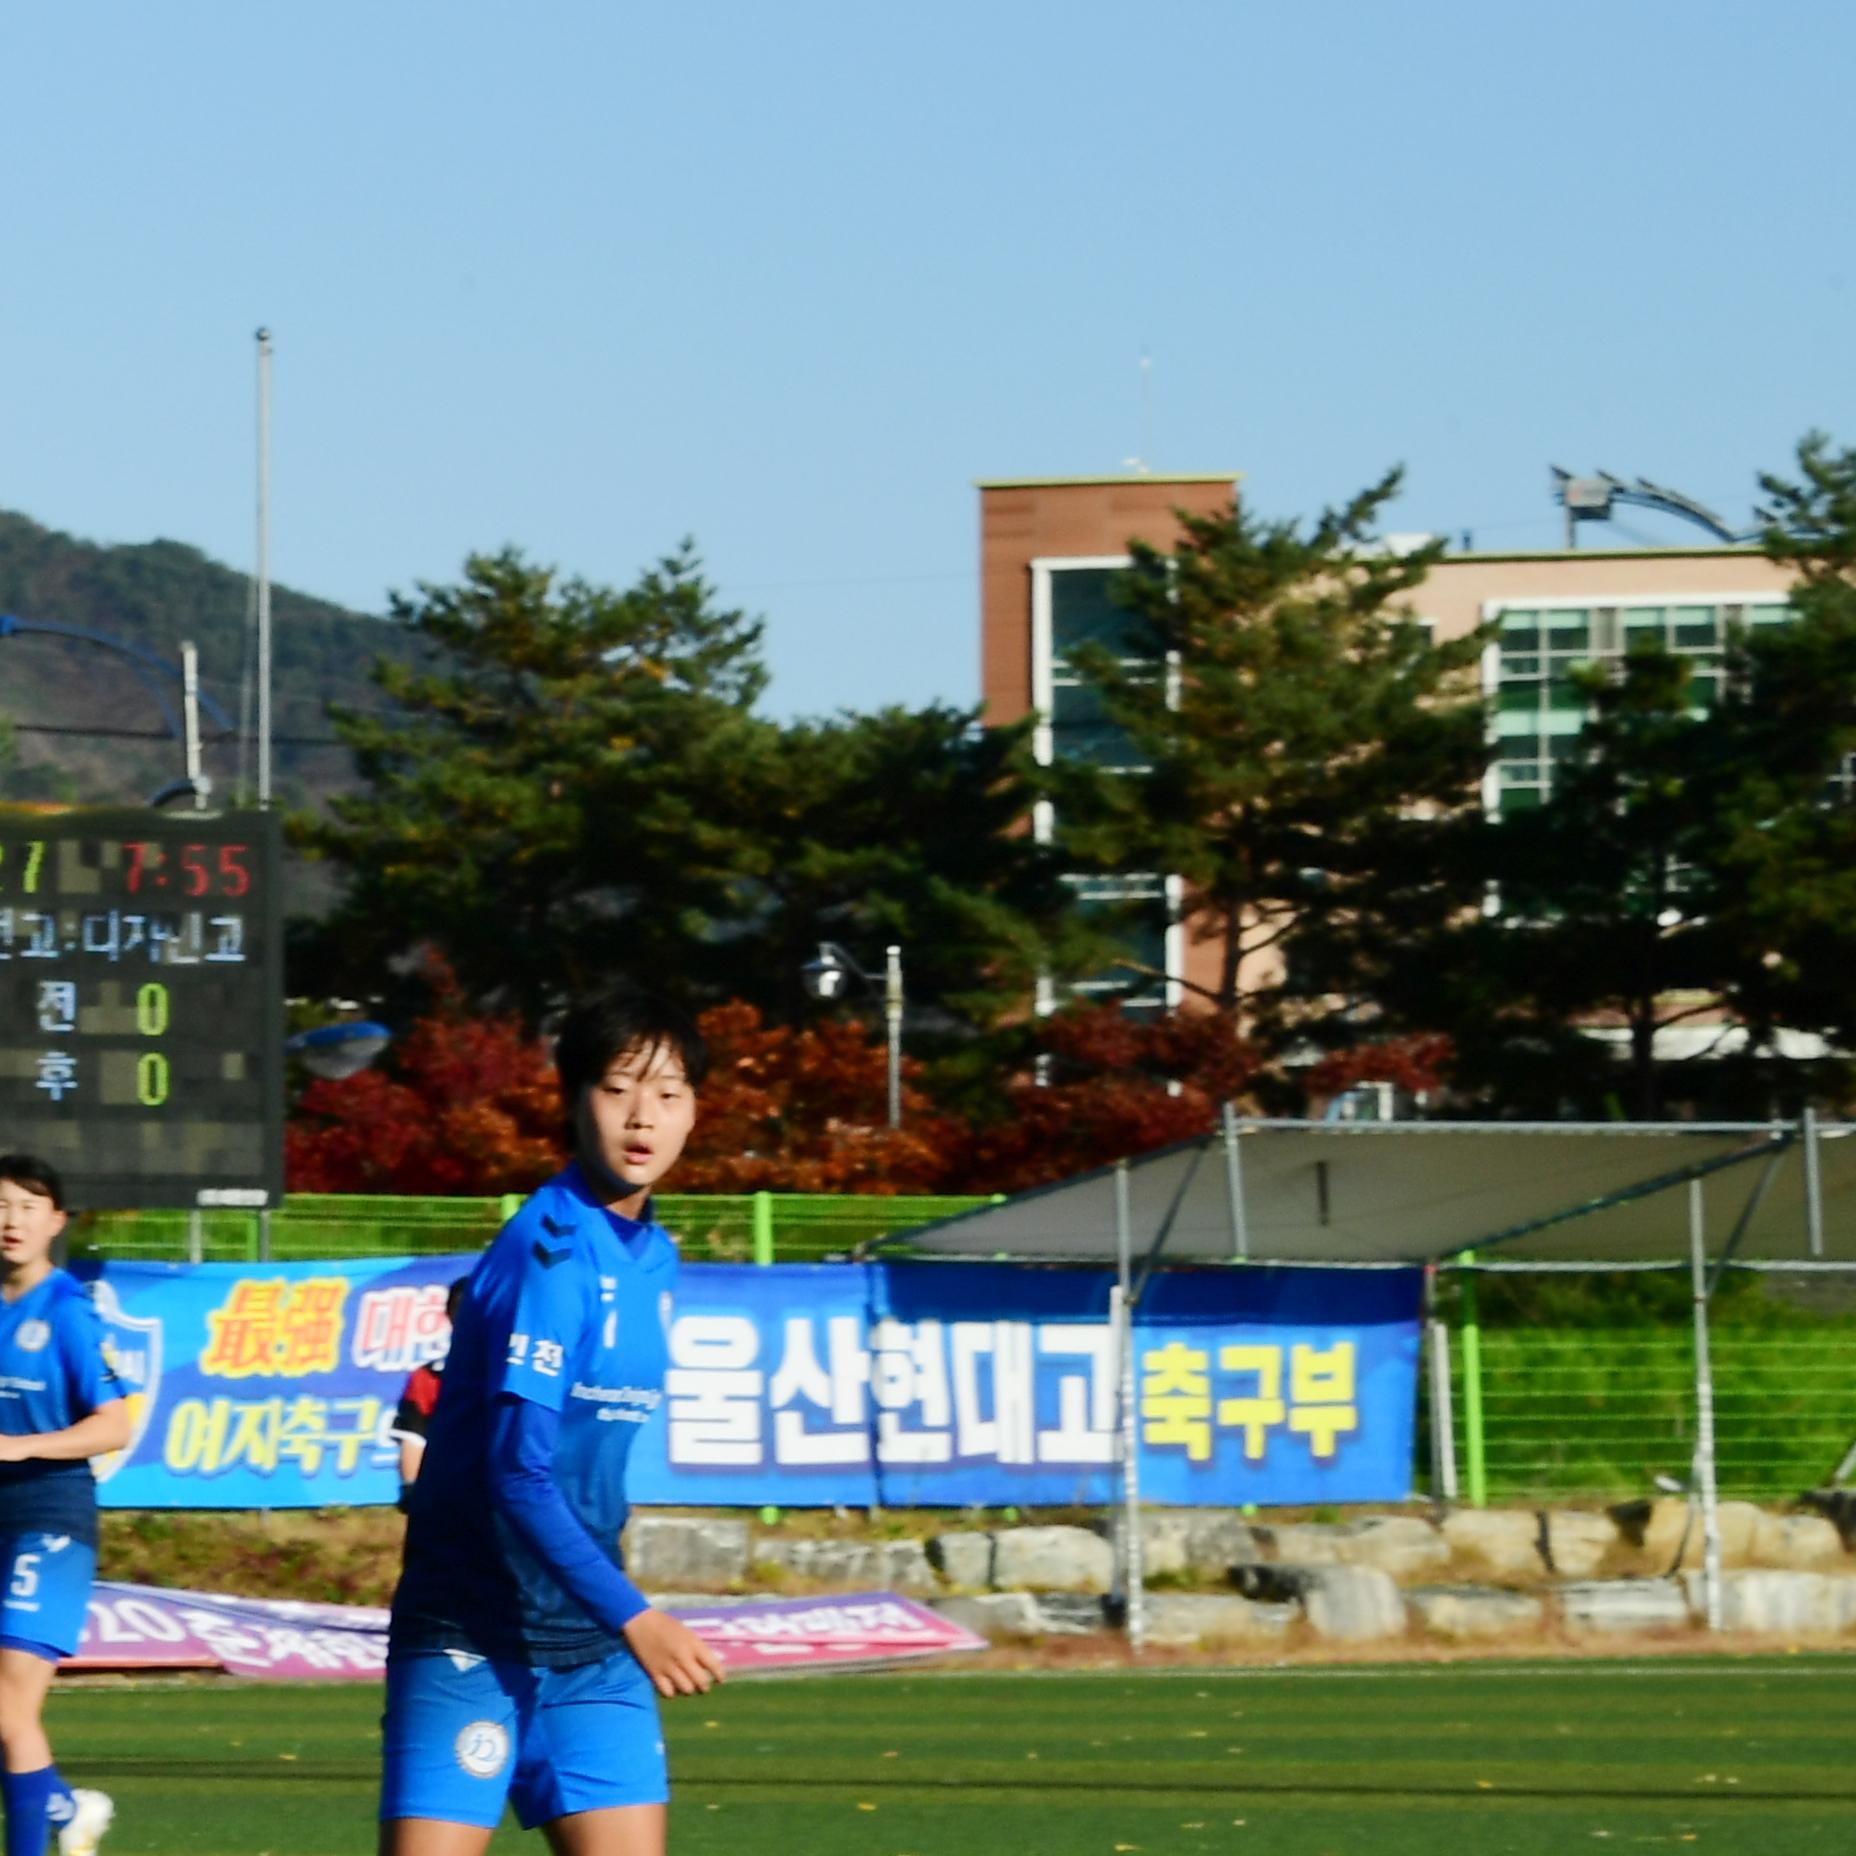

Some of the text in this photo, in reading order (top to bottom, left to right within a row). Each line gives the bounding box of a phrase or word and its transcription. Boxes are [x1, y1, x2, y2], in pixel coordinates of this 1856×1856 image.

[37, 981, 76, 1032] 전
[136, 982, 169, 1036] 0
[36, 1050, 77, 1101] 후
[136, 1052, 169, 1105] 0
[665, 1313, 1358, 1468] 울산현대고 축구부
[10, 1554, 42, 1596] 5
